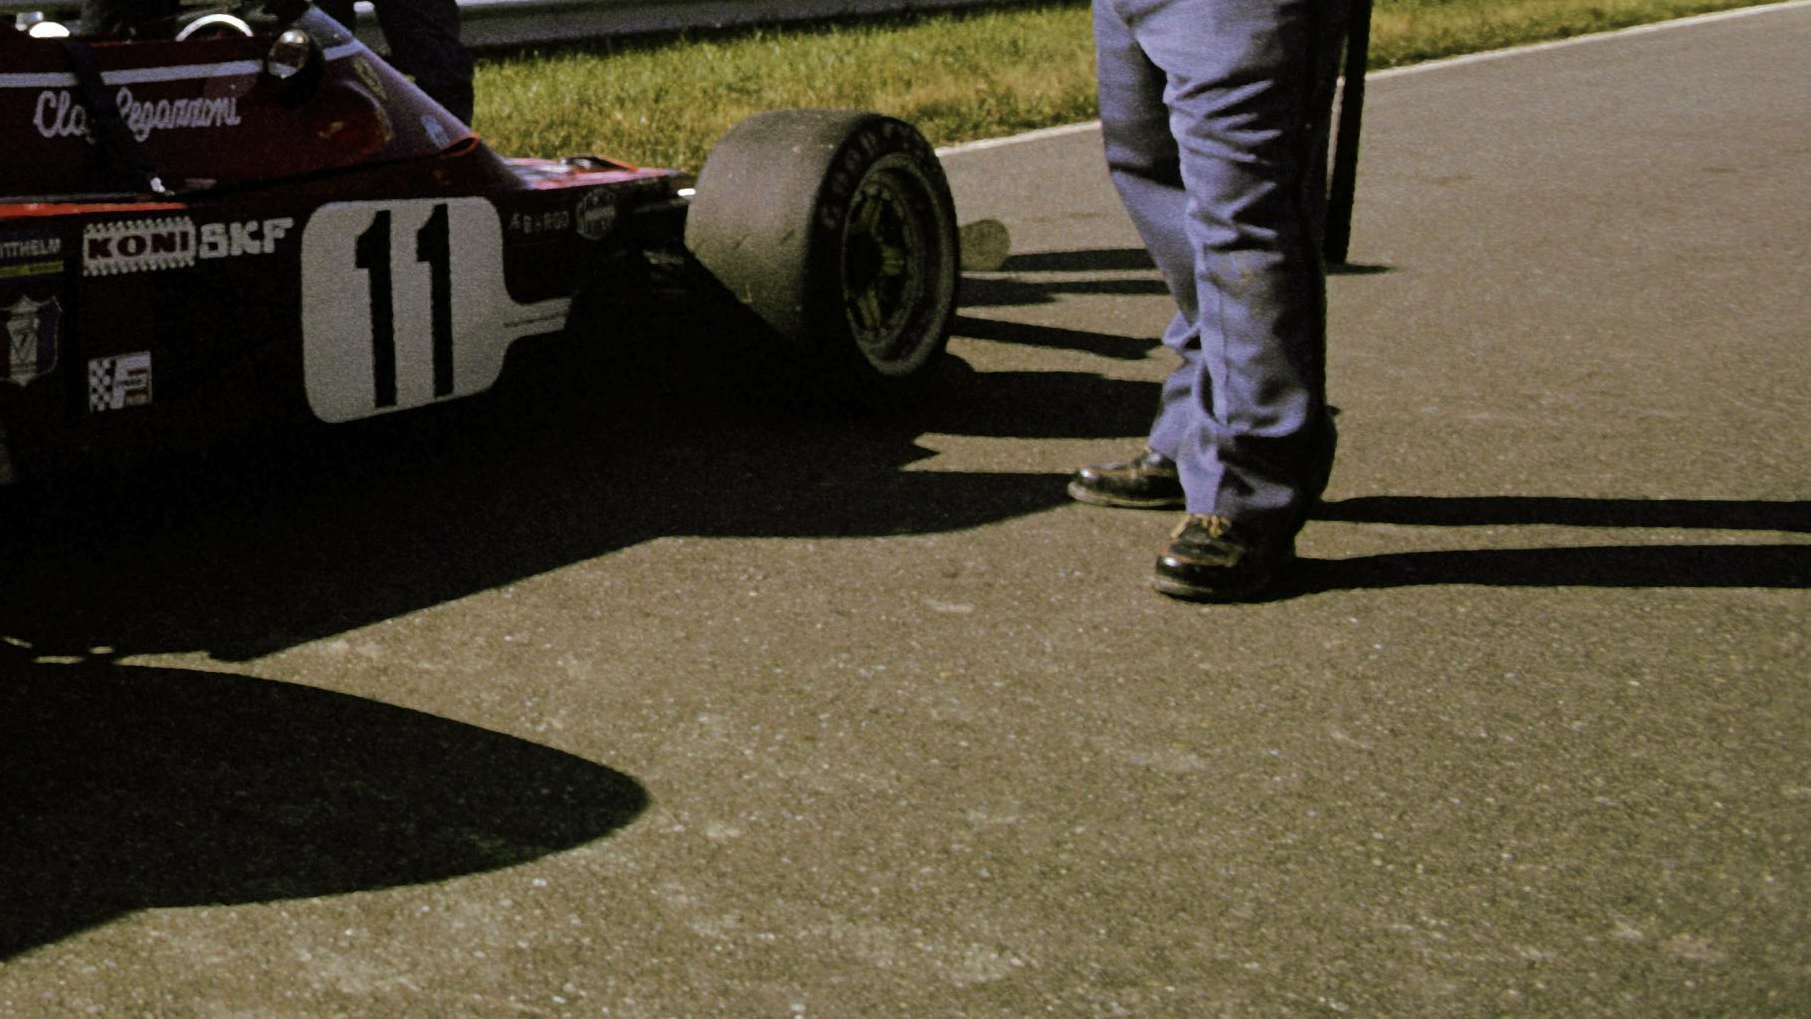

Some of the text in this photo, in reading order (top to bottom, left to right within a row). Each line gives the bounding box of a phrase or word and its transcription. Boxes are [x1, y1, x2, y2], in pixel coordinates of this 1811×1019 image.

[87, 230, 190, 260] KONI
[198, 217, 295, 260] SKF
[354, 202, 456, 409] 11
